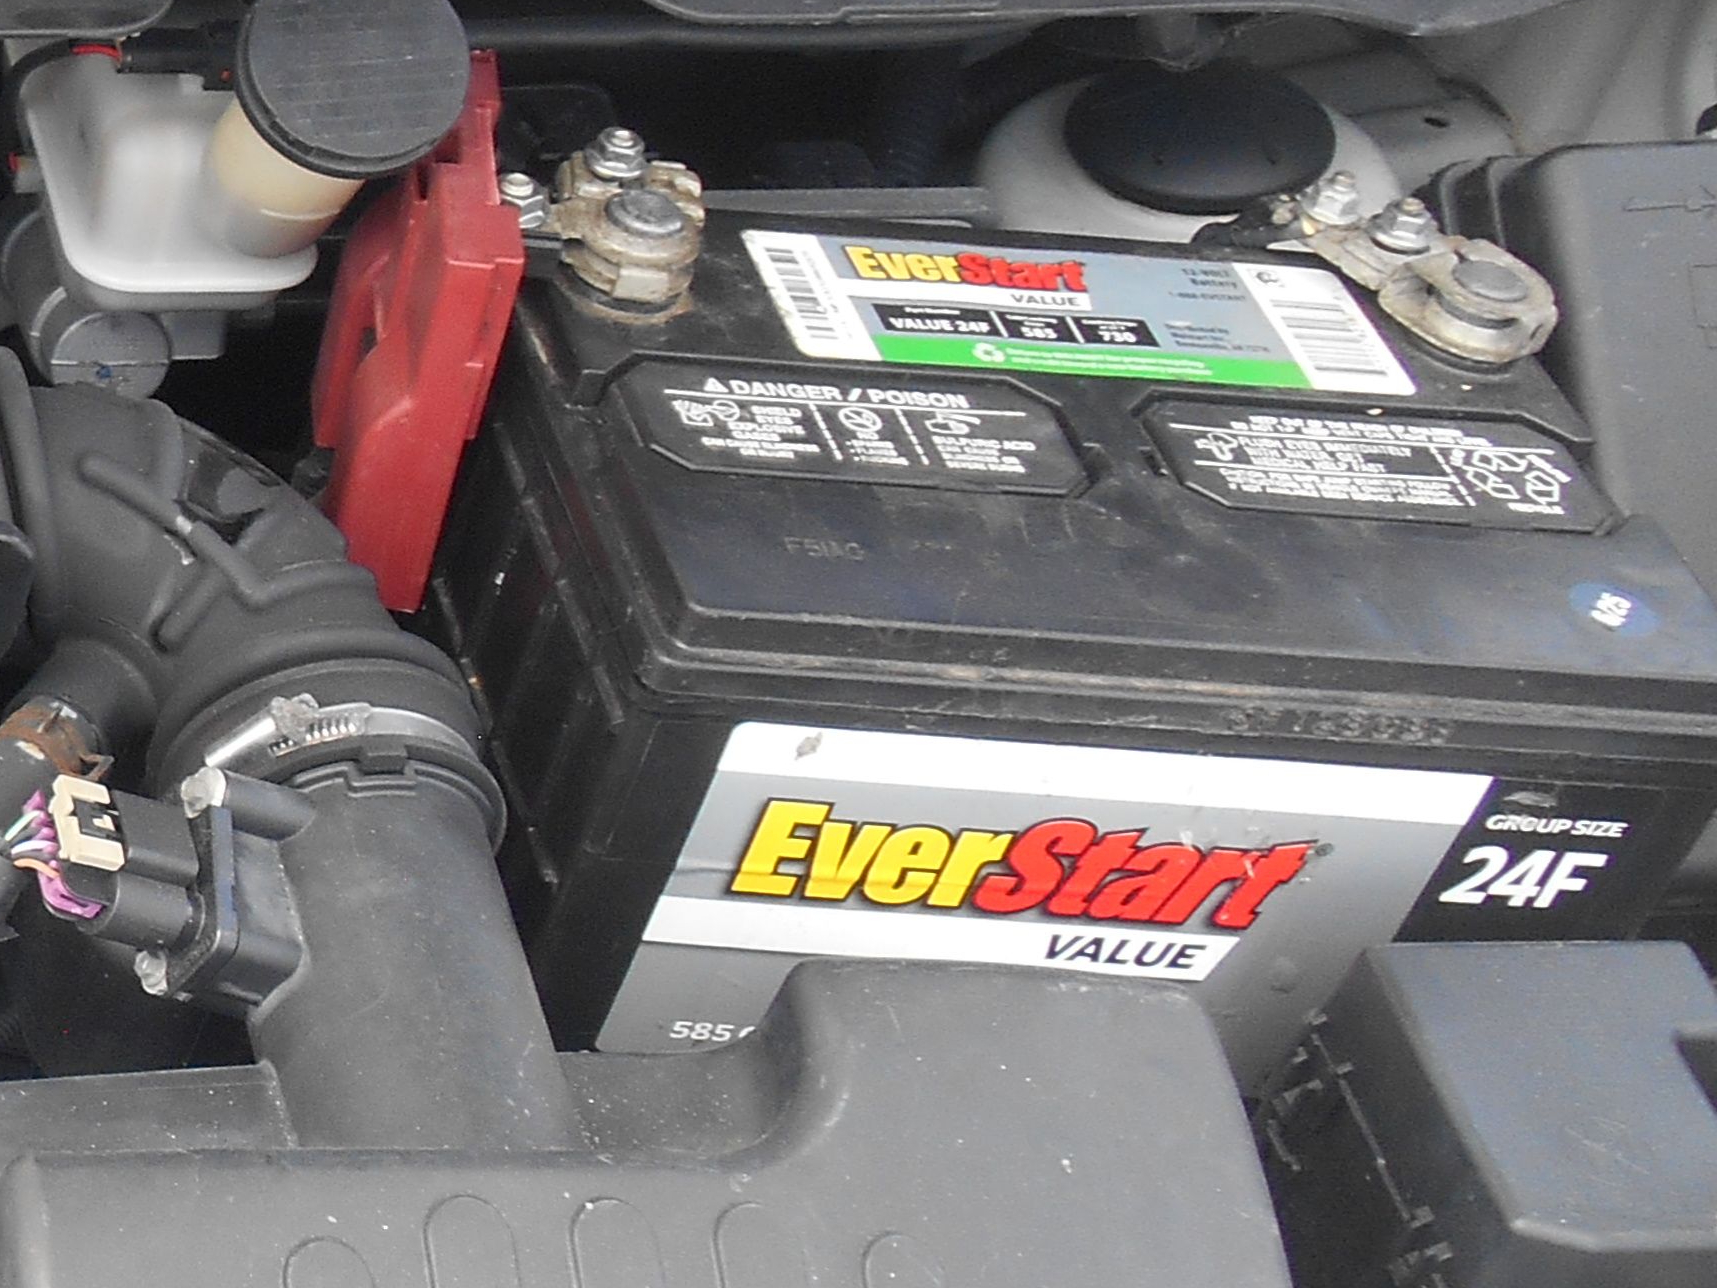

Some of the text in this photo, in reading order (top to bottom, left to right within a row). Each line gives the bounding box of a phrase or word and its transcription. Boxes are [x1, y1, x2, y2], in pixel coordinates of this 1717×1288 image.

[843, 245, 1088, 293] EverStart
[1011, 293, 1079, 308] VALUE
[889, 317, 953, 331] VALUE
[955, 320, 991, 333] 24F
[729, 380, 843, 400] DANGER
[867, 389, 970, 409] POISON
[1485, 814, 1629, 838] GROUP SIZE
[728, 795, 1317, 931] EverStart
[1438, 845, 1609, 909] 24F
[1044, 934, 1208, 970] VALUE
[670, 1020, 734, 1043] 585
